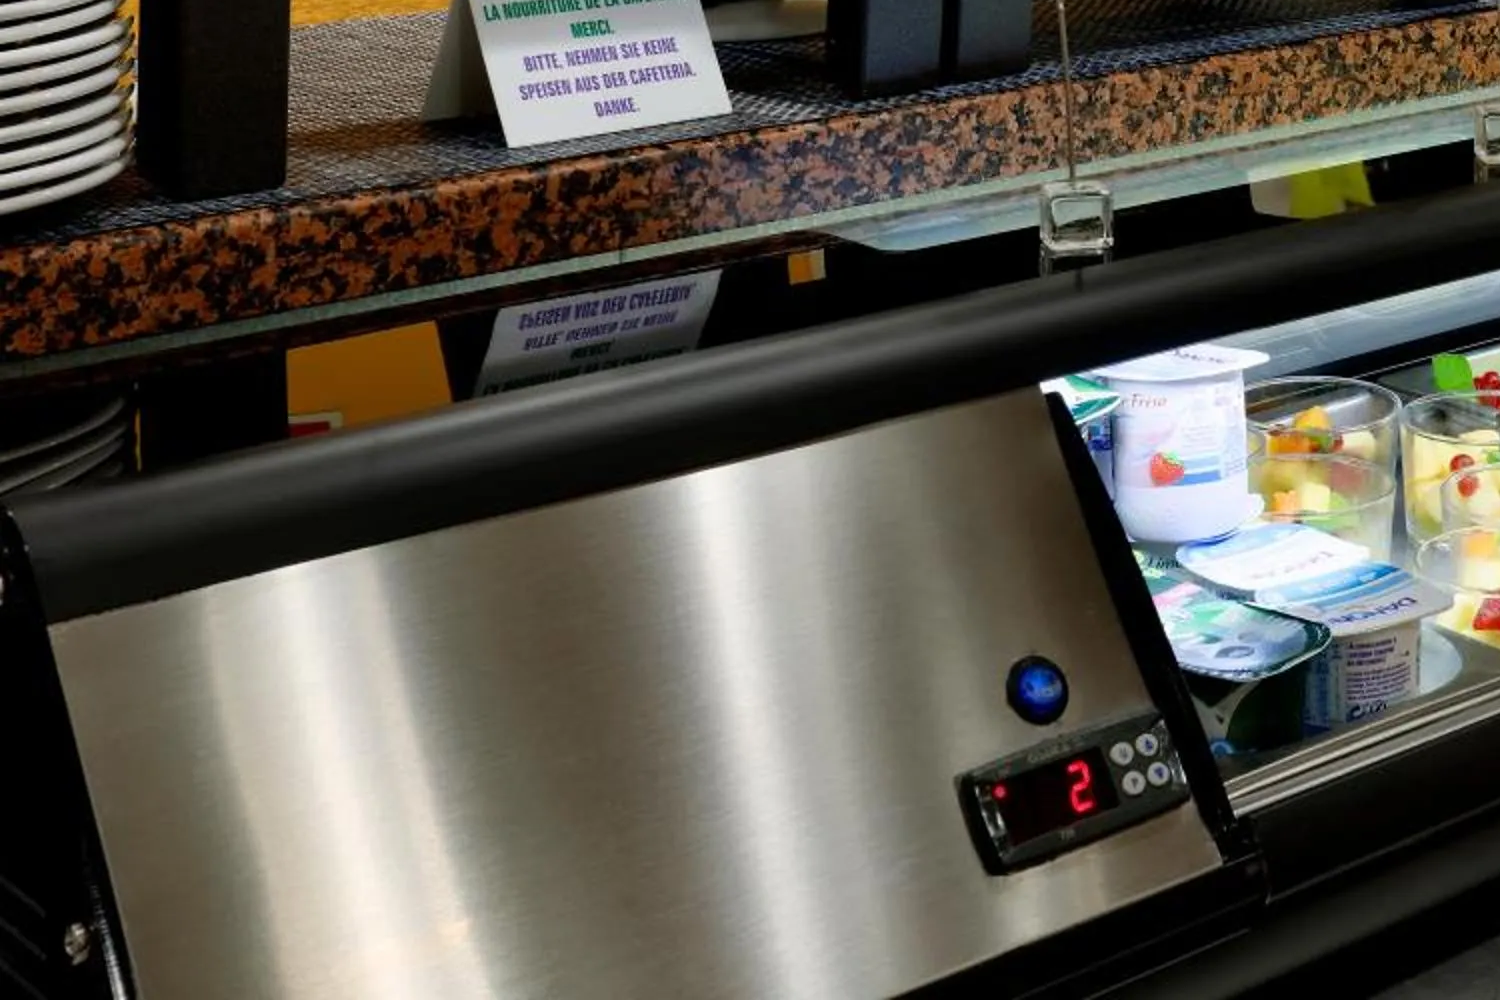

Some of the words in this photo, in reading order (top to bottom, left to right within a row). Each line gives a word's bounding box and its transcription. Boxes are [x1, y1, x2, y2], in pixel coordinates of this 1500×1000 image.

[483, 4, 501, 21] LA
[570, 19, 615, 38] MERCI.
[565, 45, 618, 66] NEHMEN
[620, 41, 641, 59] SIE
[642, 37, 679, 56] KEINE
[519, 79, 572, 101] SPEISEN
[575, 75, 601, 93] AUS
[602, 71, 628, 89] DER
[629, 62, 697, 85] CAFETERIA.
[594, 98, 640, 118] DANKE.
[1067, 760, 1095, 814] 2
